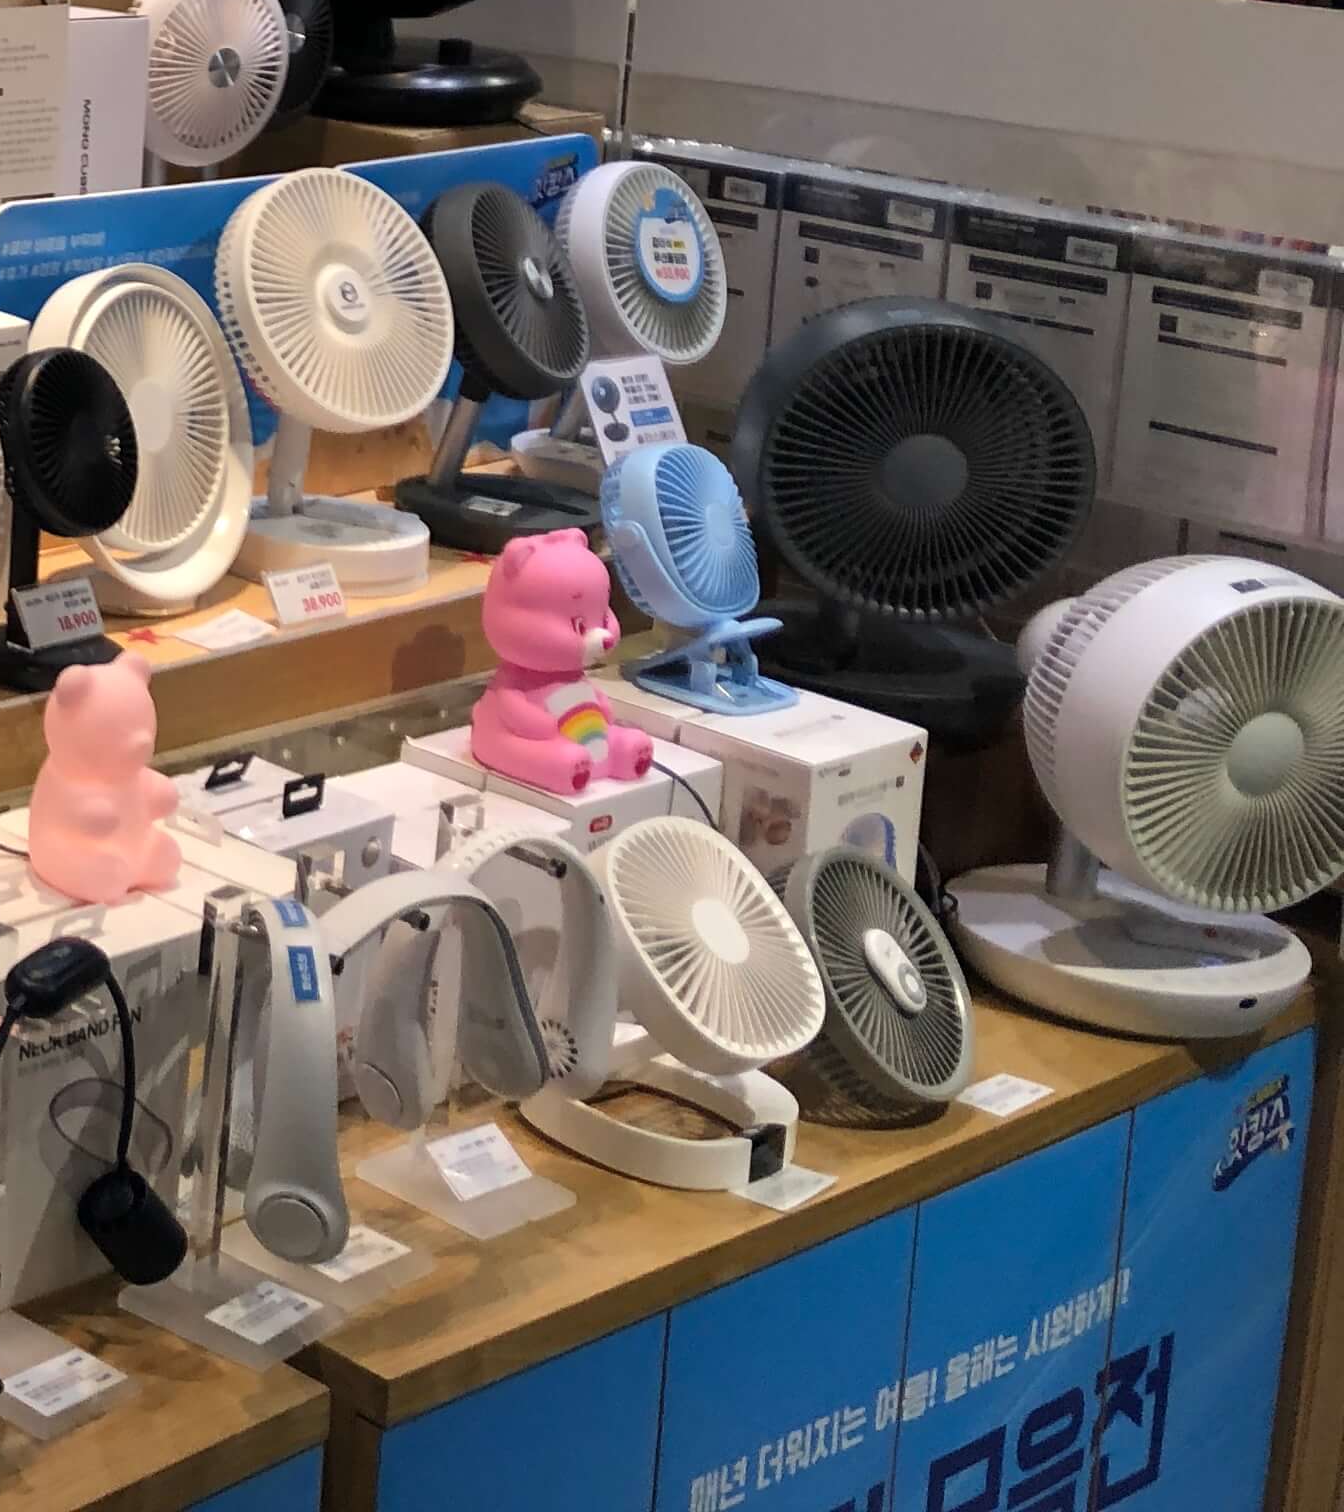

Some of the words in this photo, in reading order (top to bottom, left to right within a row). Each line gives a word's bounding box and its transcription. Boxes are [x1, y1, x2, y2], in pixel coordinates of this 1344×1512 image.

[66, 1018, 110, 1046] BAND
[112, 1006, 142, 1032] FN
[689, 1456, 749, 1512] 매년
[757, 1406, 868, 1485] 더워지는
[945, 1333, 1019, 1405] 올해는
[1024, 1267, 1132, 1362] 시원하게!
